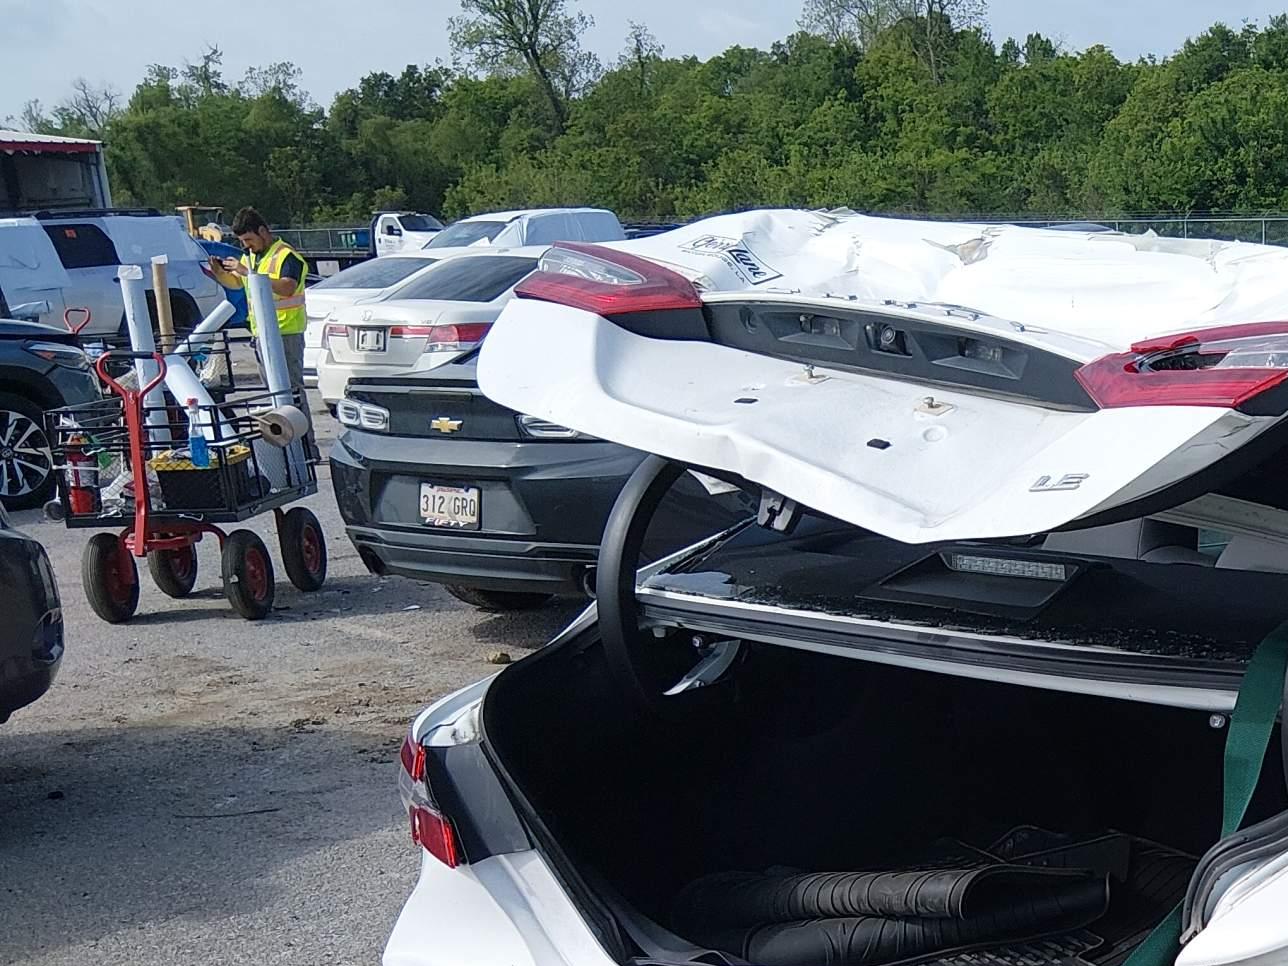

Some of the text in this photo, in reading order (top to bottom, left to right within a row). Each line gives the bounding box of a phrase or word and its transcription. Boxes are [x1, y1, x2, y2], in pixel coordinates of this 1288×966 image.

[726, 248, 768, 279] Lane
[1028, 472, 1091, 493] LE
[421, 493, 477, 518] 312 GRQ
